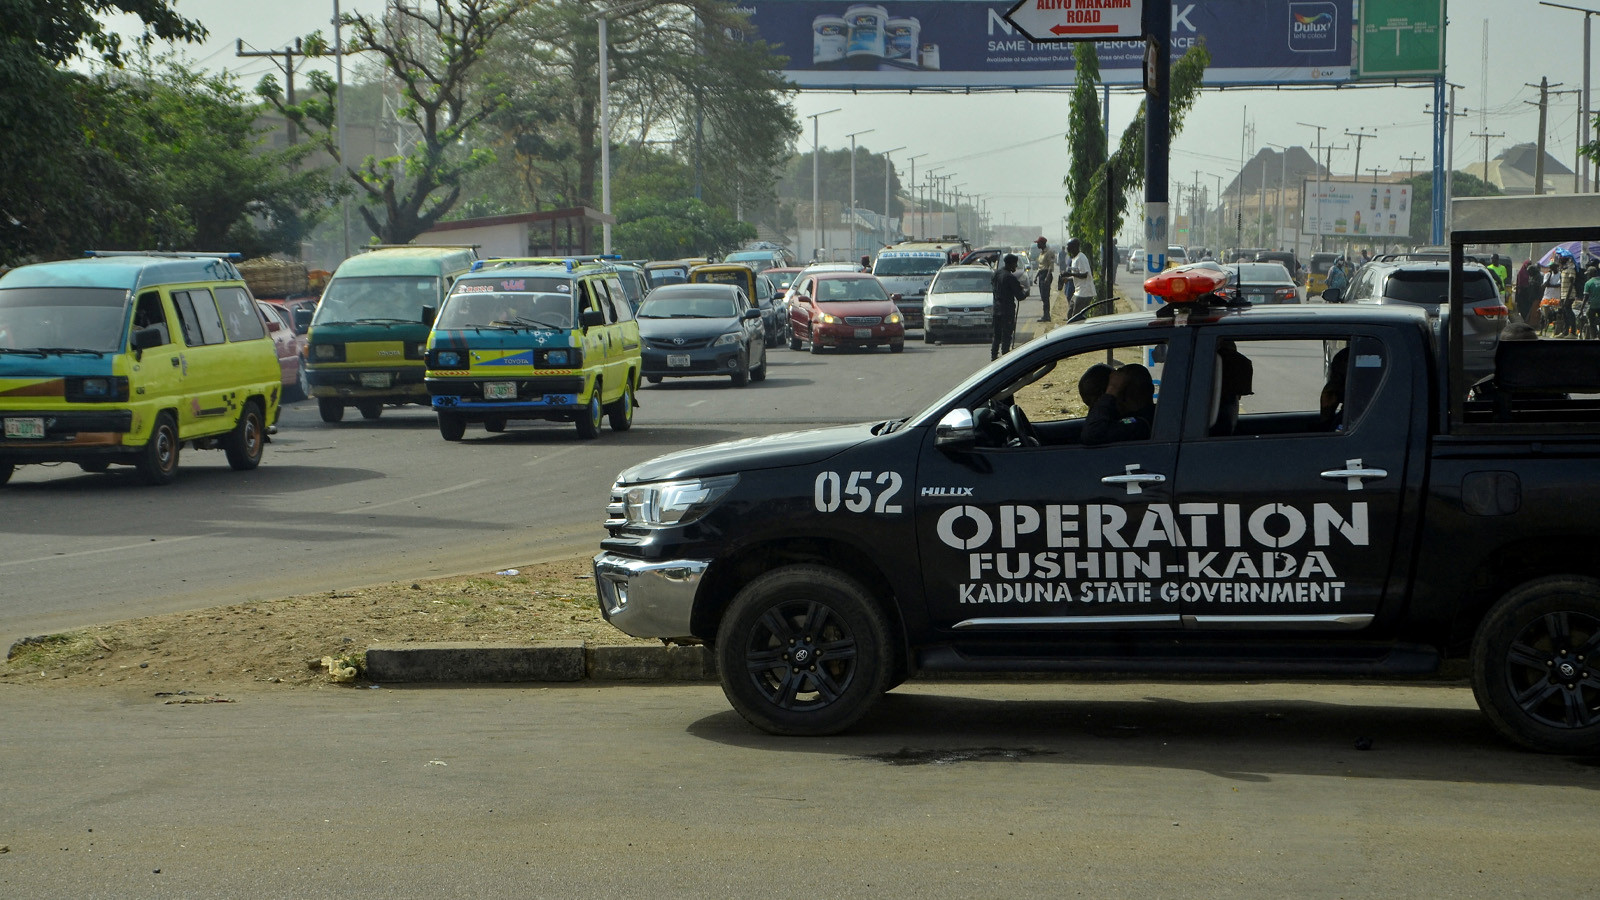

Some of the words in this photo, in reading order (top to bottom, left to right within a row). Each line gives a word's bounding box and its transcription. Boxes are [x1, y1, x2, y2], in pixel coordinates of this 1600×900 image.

[1037, 0, 1072, 10] ALIYU
[1075, 0, 1131, 9] MAKAMA
[1067, 10, 1101, 23] ROAD
[1294, 22, 1327, 32] Dulux
[988, 41, 1025, 51] SAME
[814, 471, 903, 514] 052
[921, 487, 974, 497] HILUX
[936, 502, 1369, 549] OPERATION
[969, 551, 1337, 580] FUSHIN-KADA
[959, 582, 1071, 604] KADUNA
[1080, 581, 1151, 603] STATE
[1160, 581, 1346, 603] GOVERNMENT
